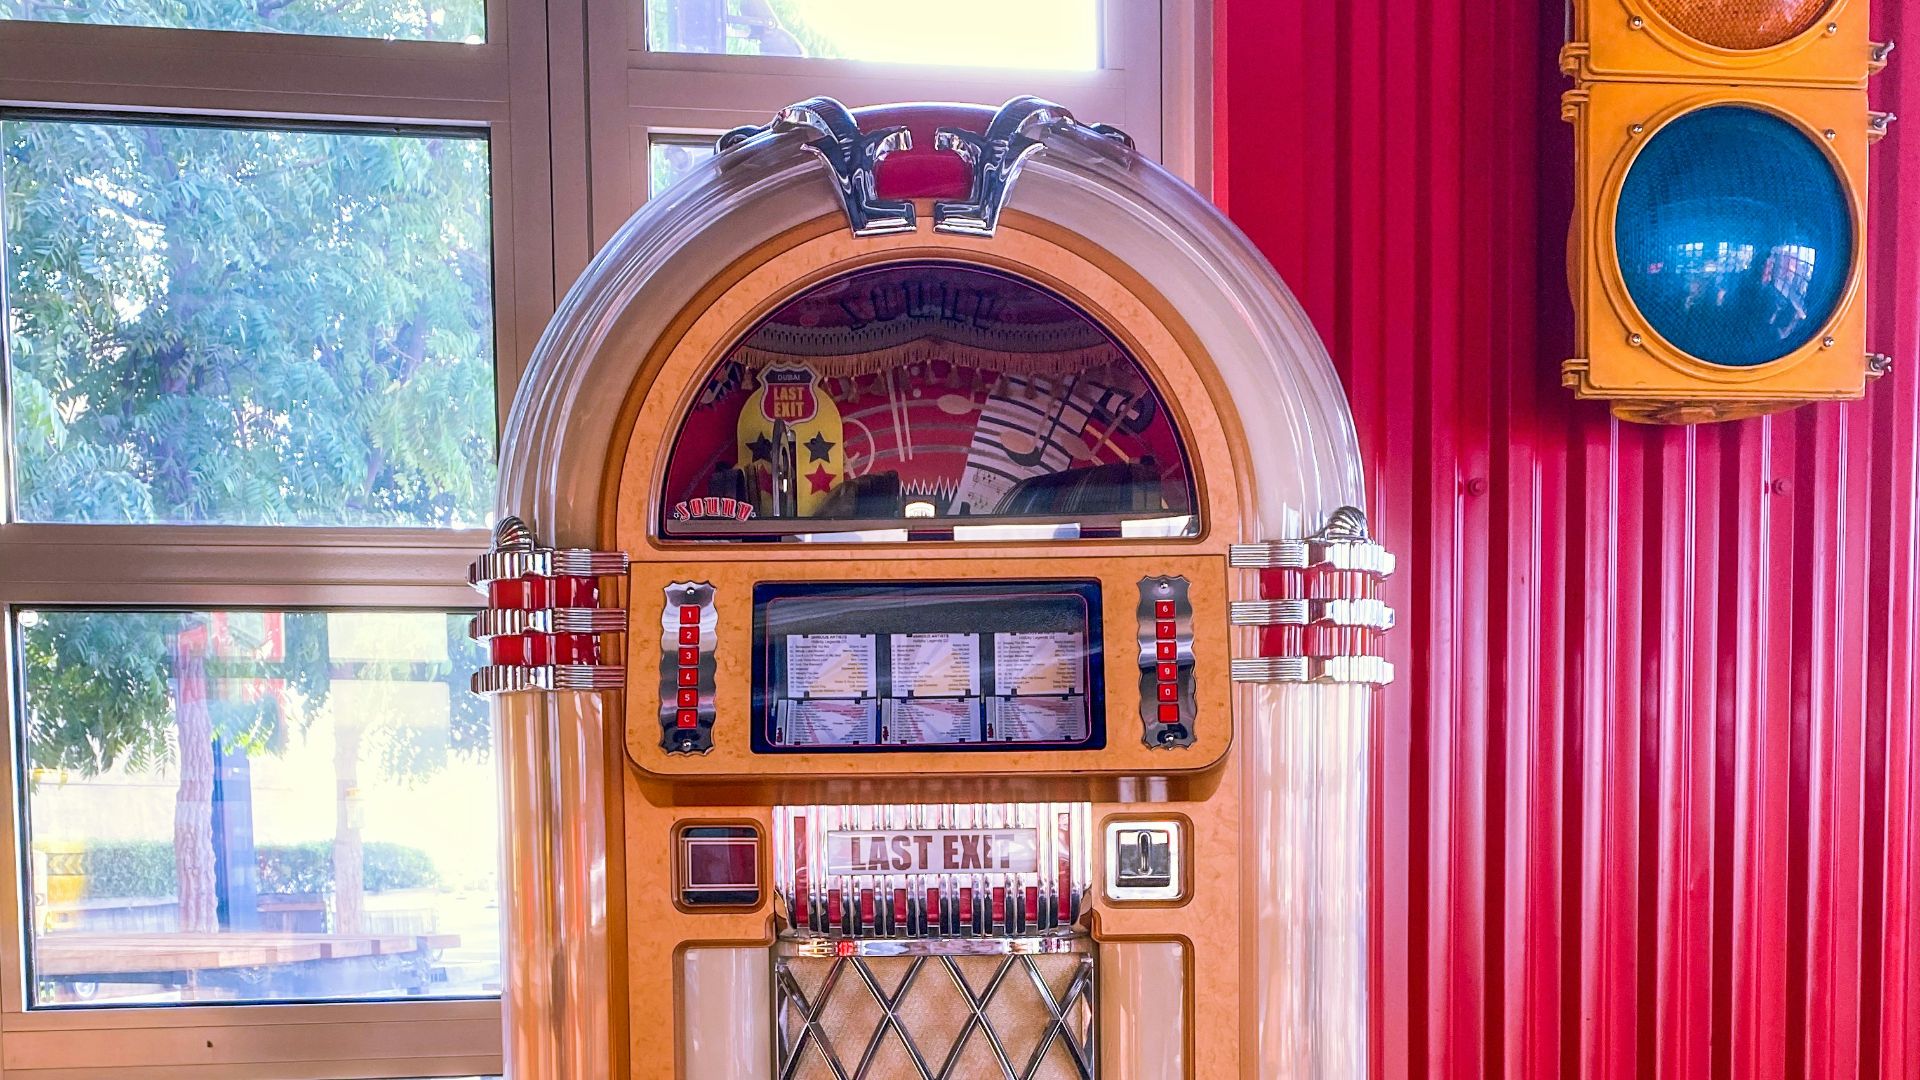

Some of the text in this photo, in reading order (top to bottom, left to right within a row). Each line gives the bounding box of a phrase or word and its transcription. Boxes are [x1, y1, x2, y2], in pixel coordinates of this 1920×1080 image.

[773, 386, 805, 401] LAST
[773, 401, 805, 418] EXIT
[851, 833, 1015, 871] LAST EXIT
